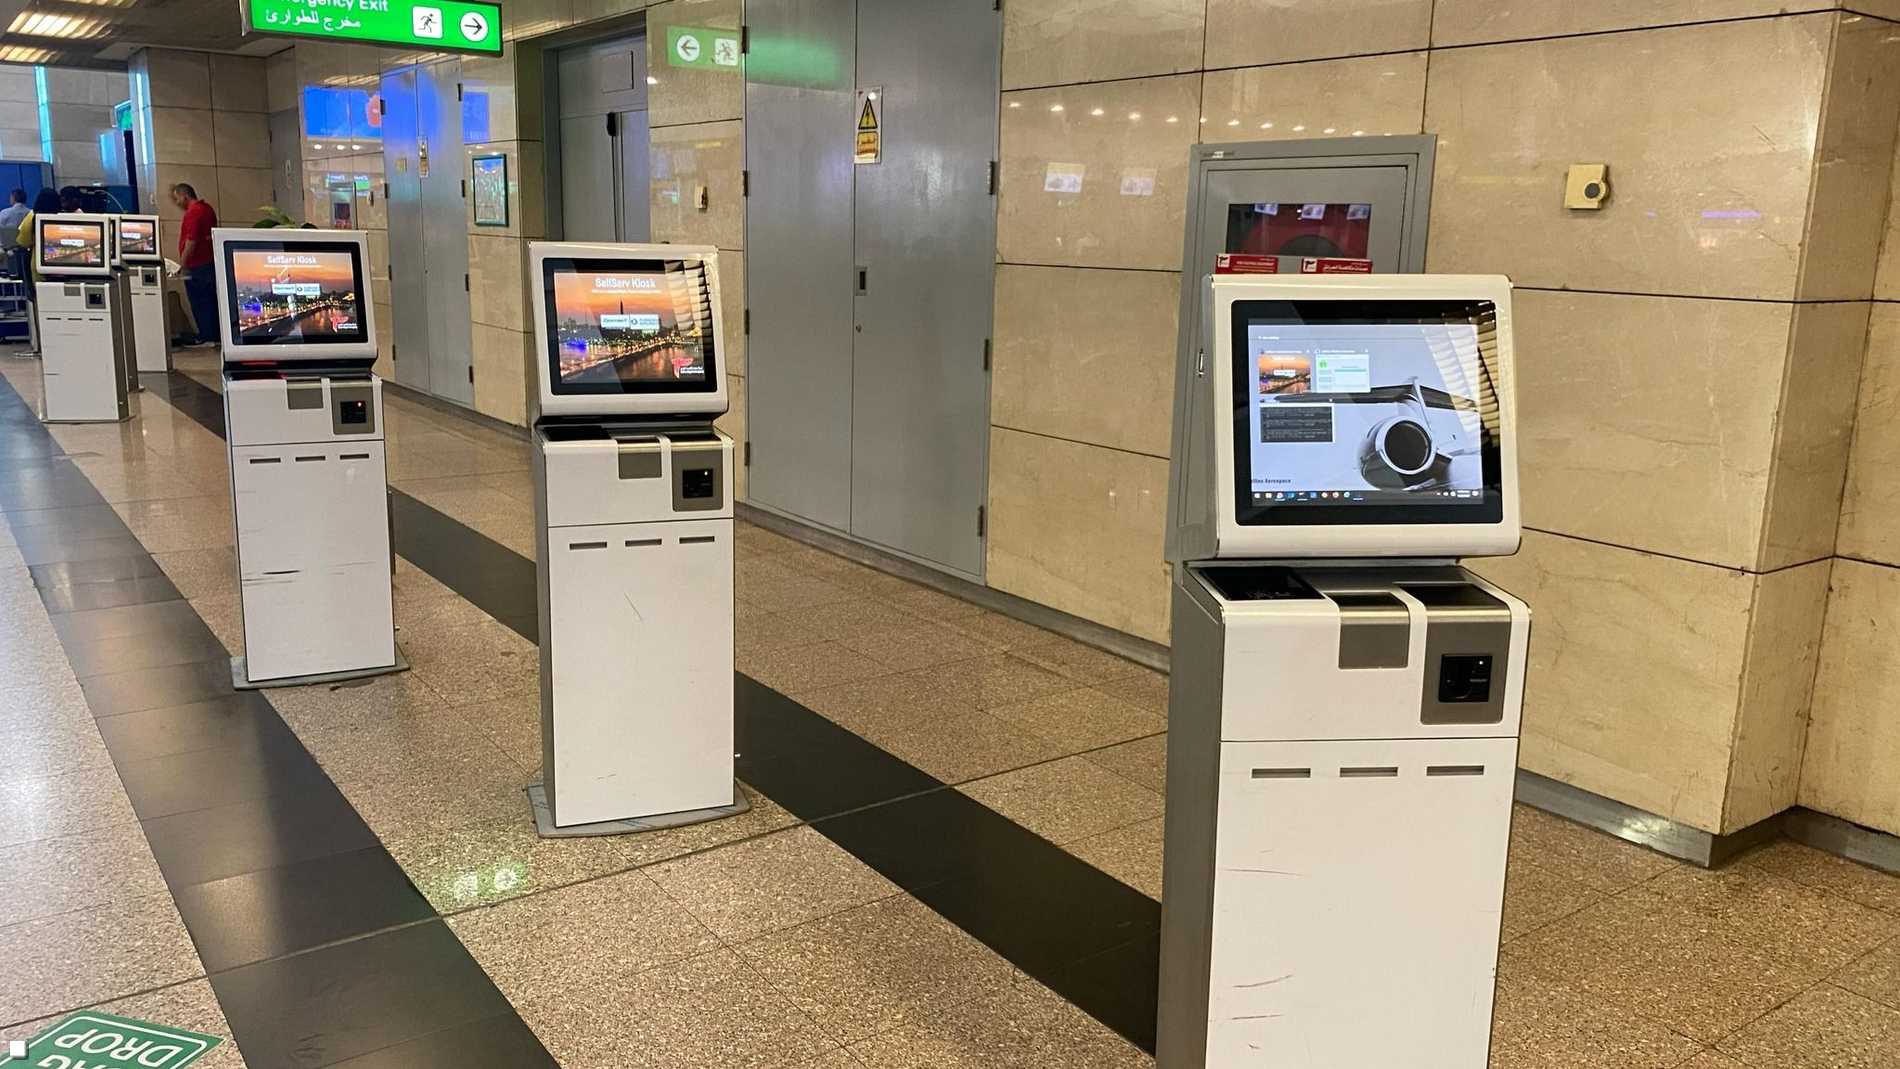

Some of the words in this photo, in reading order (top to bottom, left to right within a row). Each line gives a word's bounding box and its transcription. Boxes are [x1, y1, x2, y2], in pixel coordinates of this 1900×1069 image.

[282, 0, 353, 11] gency
[359, 0, 388, 12] Exit
[265, 8, 320, 25] للطوارئ
[323, 16, 361, 31] مخرج
[631, 278, 656, 289] Kiosk
[54, 1028, 183, 1067] DROP
